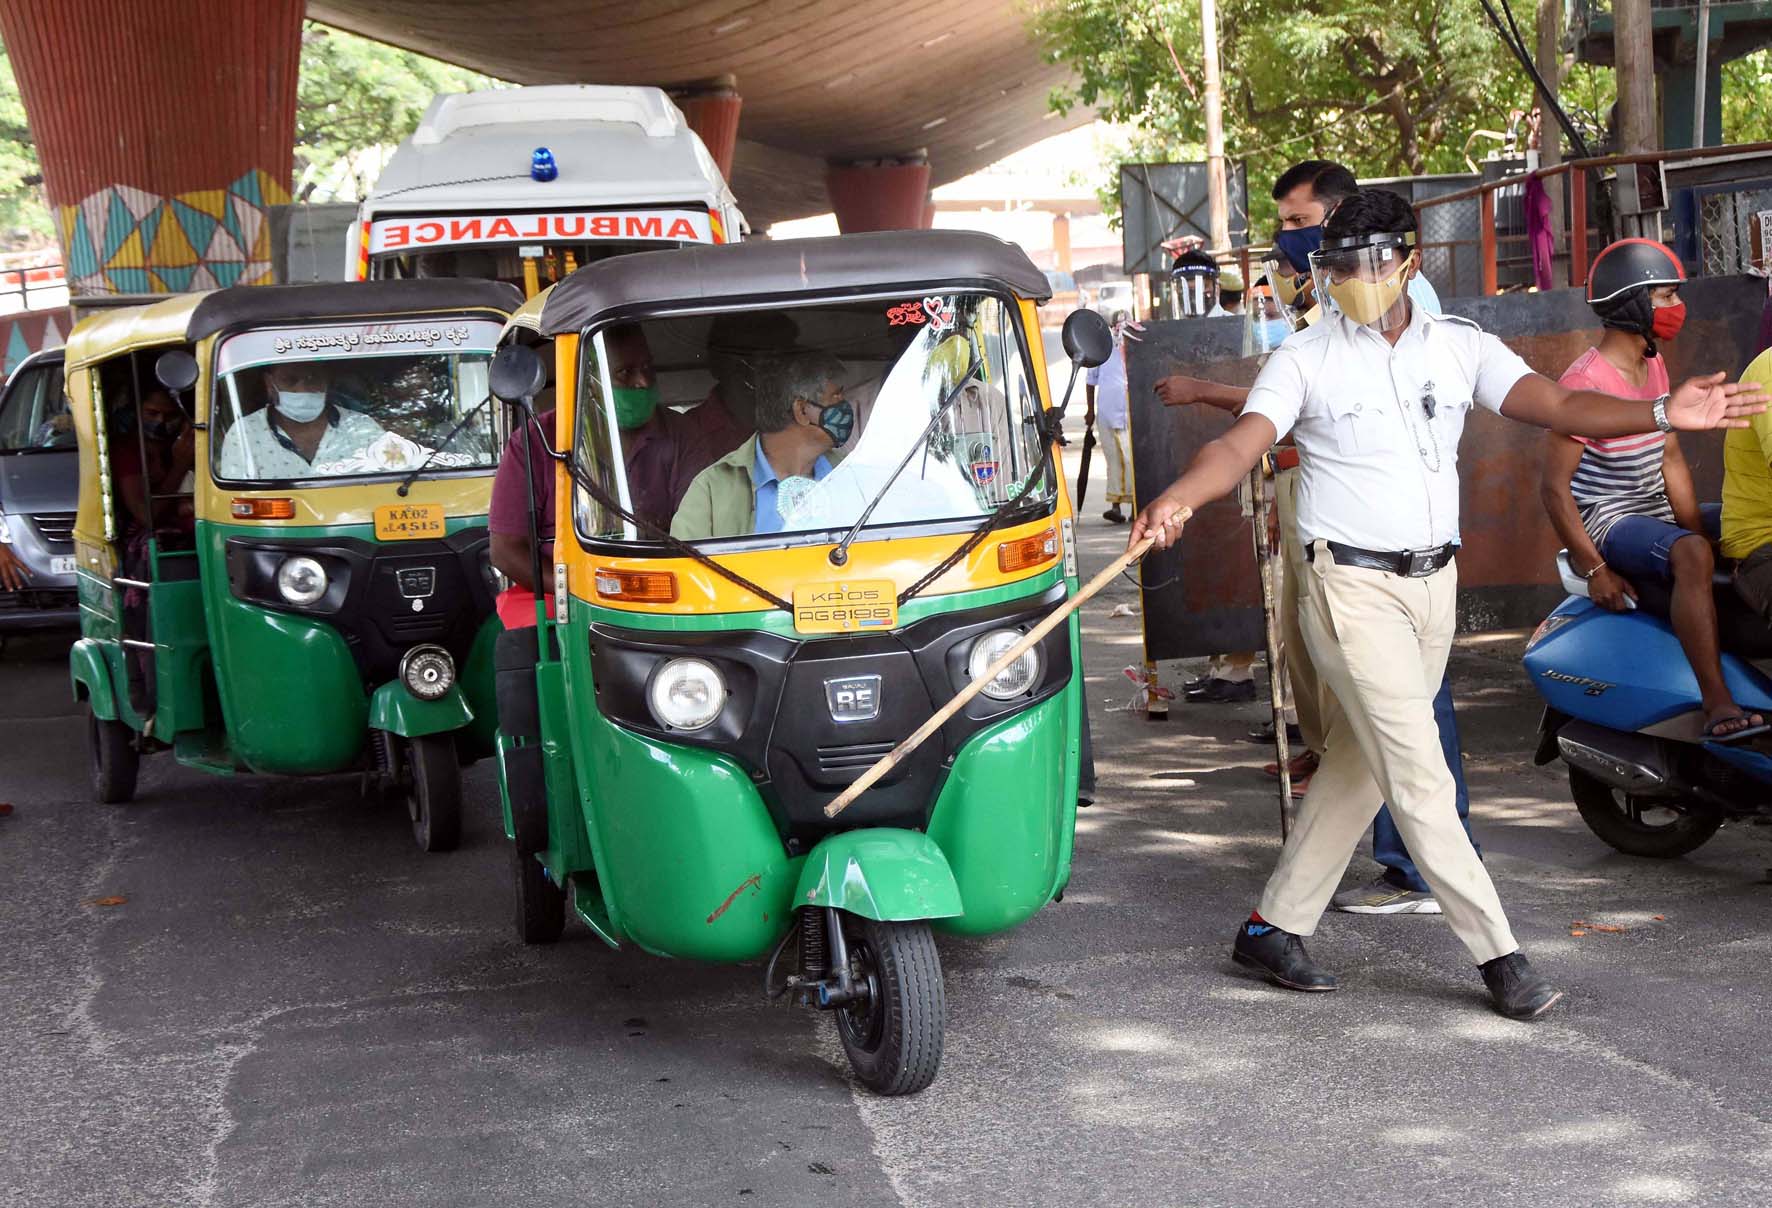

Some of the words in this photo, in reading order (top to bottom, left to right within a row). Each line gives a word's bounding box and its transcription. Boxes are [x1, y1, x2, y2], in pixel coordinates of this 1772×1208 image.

[812, 592, 843, 602] KA
[847, 590, 879, 600] 05
[799, 610, 829, 621] AG
[832, 608, 891, 621] 8198
[837, 690, 872, 711] RE
